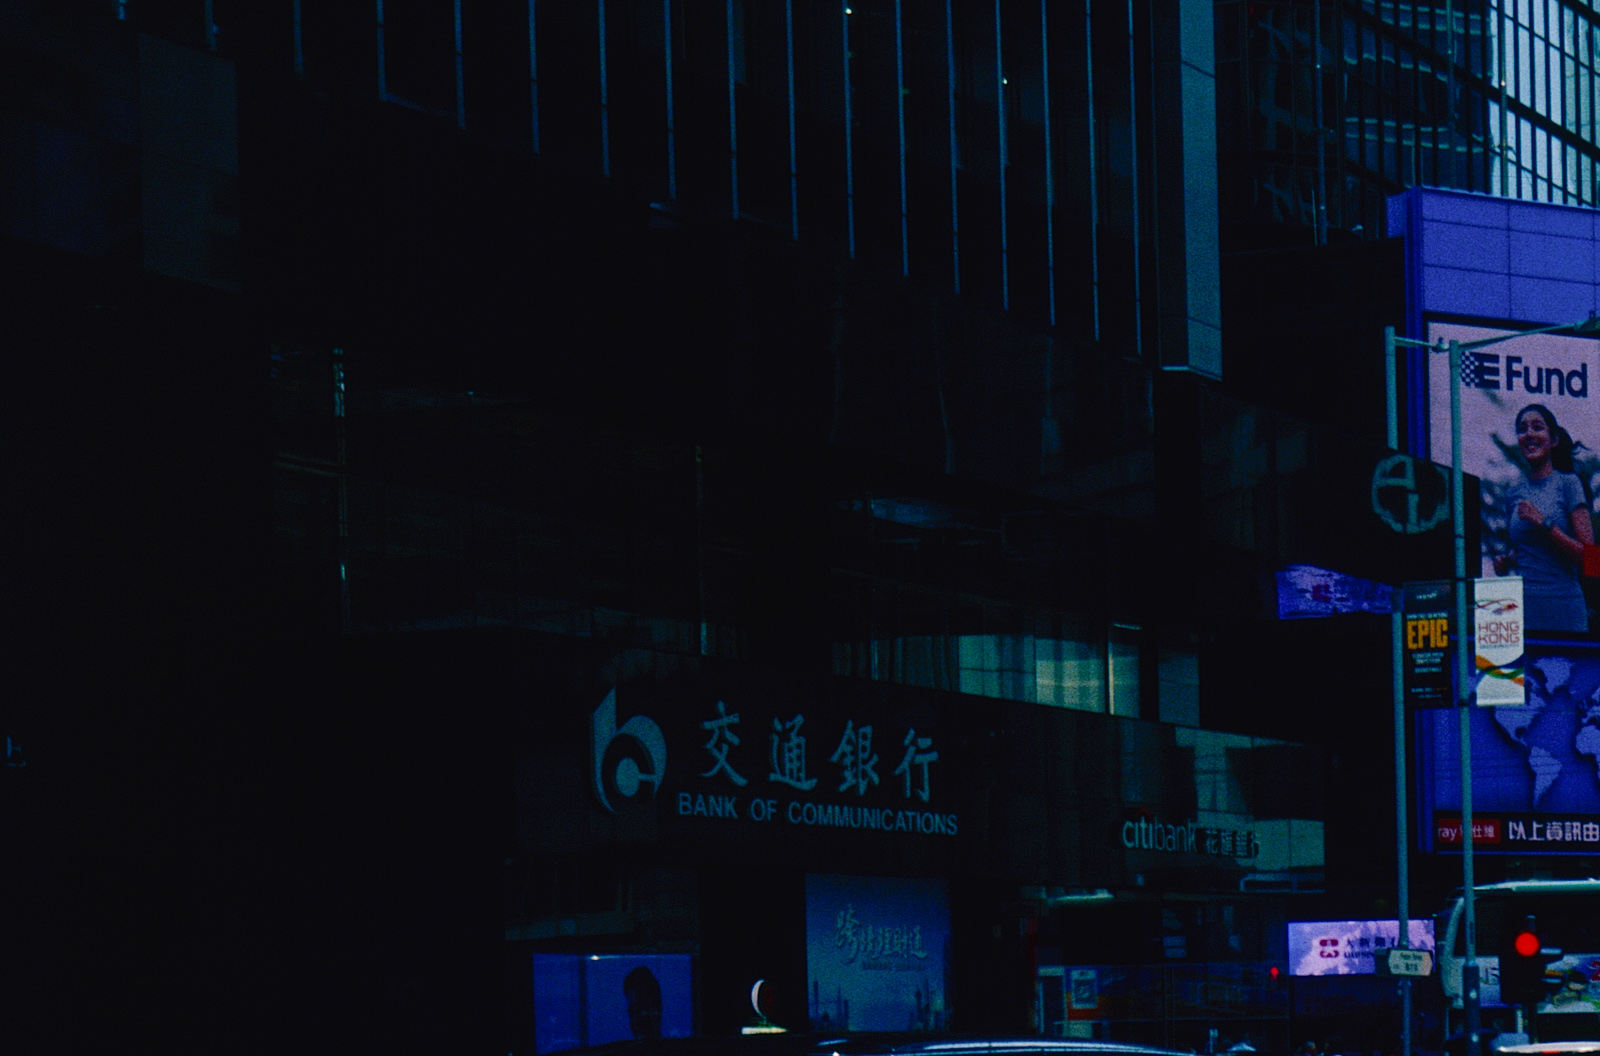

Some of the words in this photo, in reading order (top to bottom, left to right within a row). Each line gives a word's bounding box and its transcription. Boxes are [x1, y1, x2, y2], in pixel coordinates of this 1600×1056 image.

[1506, 356, 1588, 398] Fund
[1406, 618, 1449, 650] EPIC
[1478, 621, 1520, 633] HONG
[1478, 633, 1520, 645] KONG
[700, 700, 940, 803] 交通銀行
[677, 792, 739, 820] BANK
[748, 798, 778, 823] OF
[786, 801, 958, 836] COMMUNICATIONS
[1122, 815, 1197, 852] citibank
